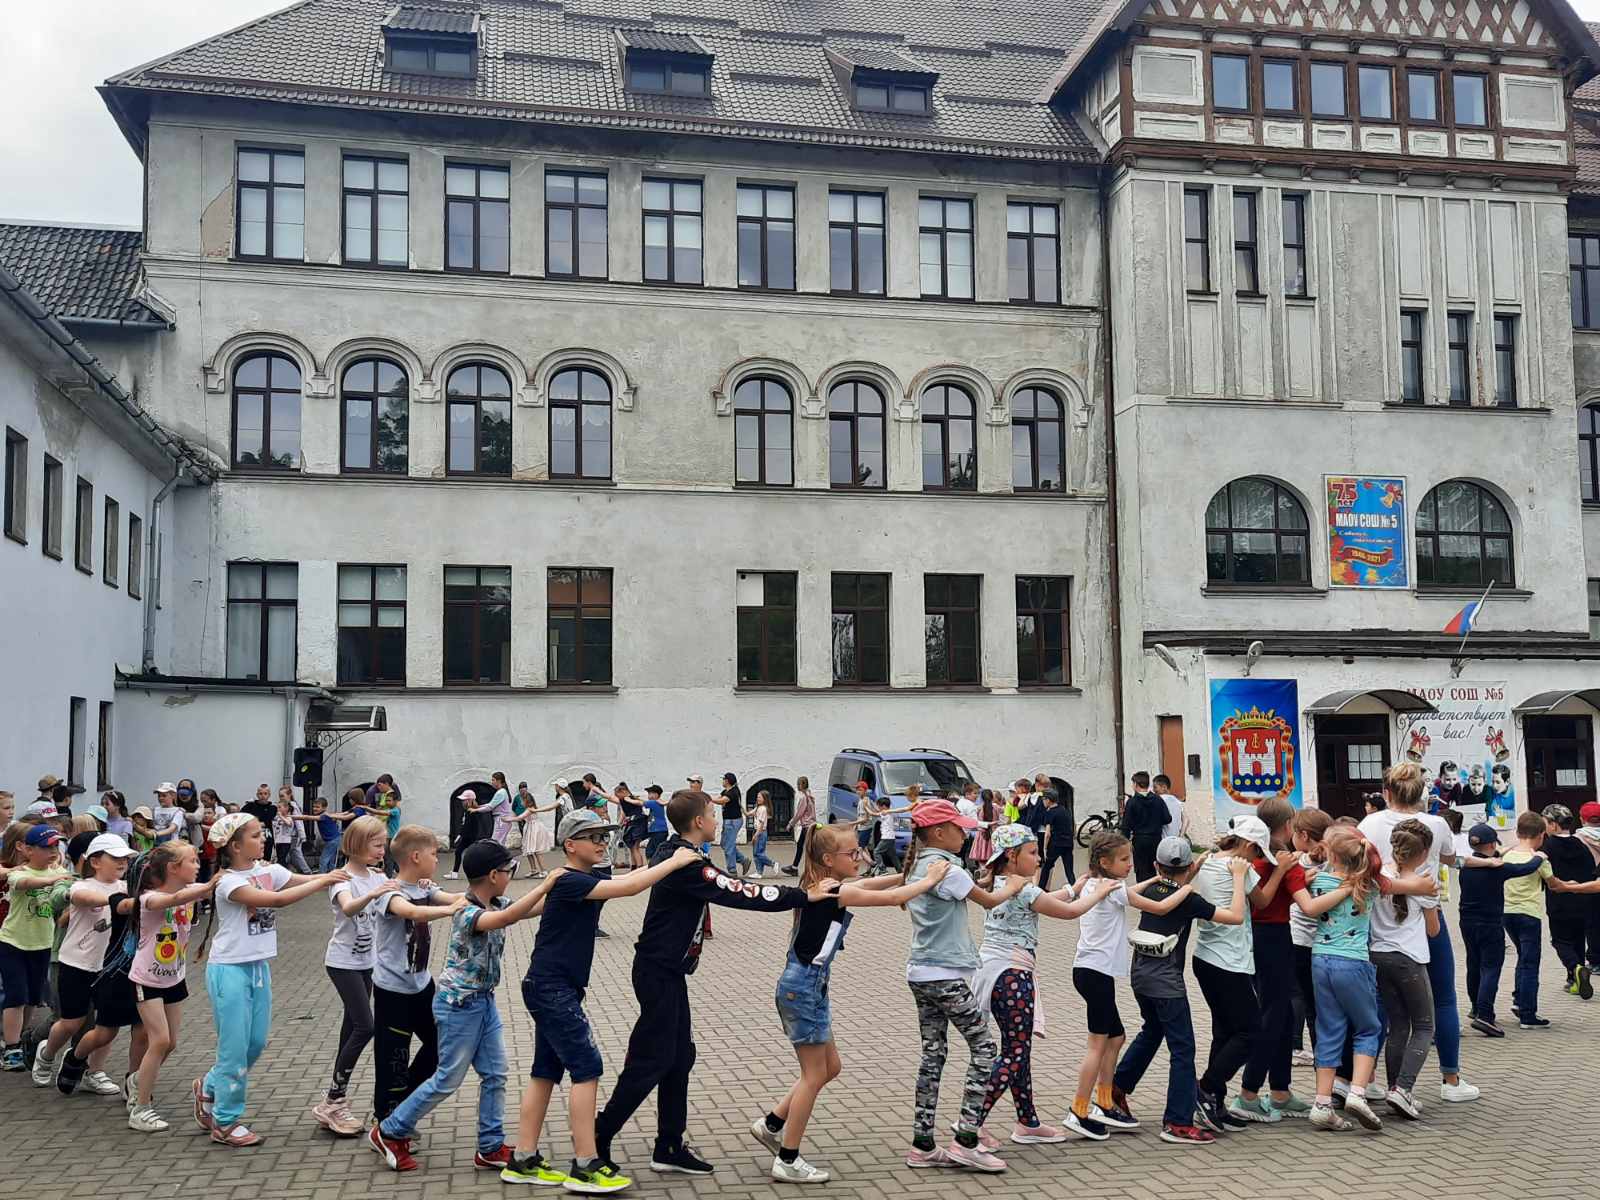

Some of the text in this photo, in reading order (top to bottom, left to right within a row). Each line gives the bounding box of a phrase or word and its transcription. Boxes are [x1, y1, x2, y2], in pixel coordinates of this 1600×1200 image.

[1331, 483, 1357, 500] 75
[1335, 513, 1359, 527] МАОУ
[1360, 513, 1380, 528] СОШ
[1450, 688, 1479, 701] СОШ
[1484, 688, 1505, 701] №5
[1442, 722, 1475, 740] вас!
